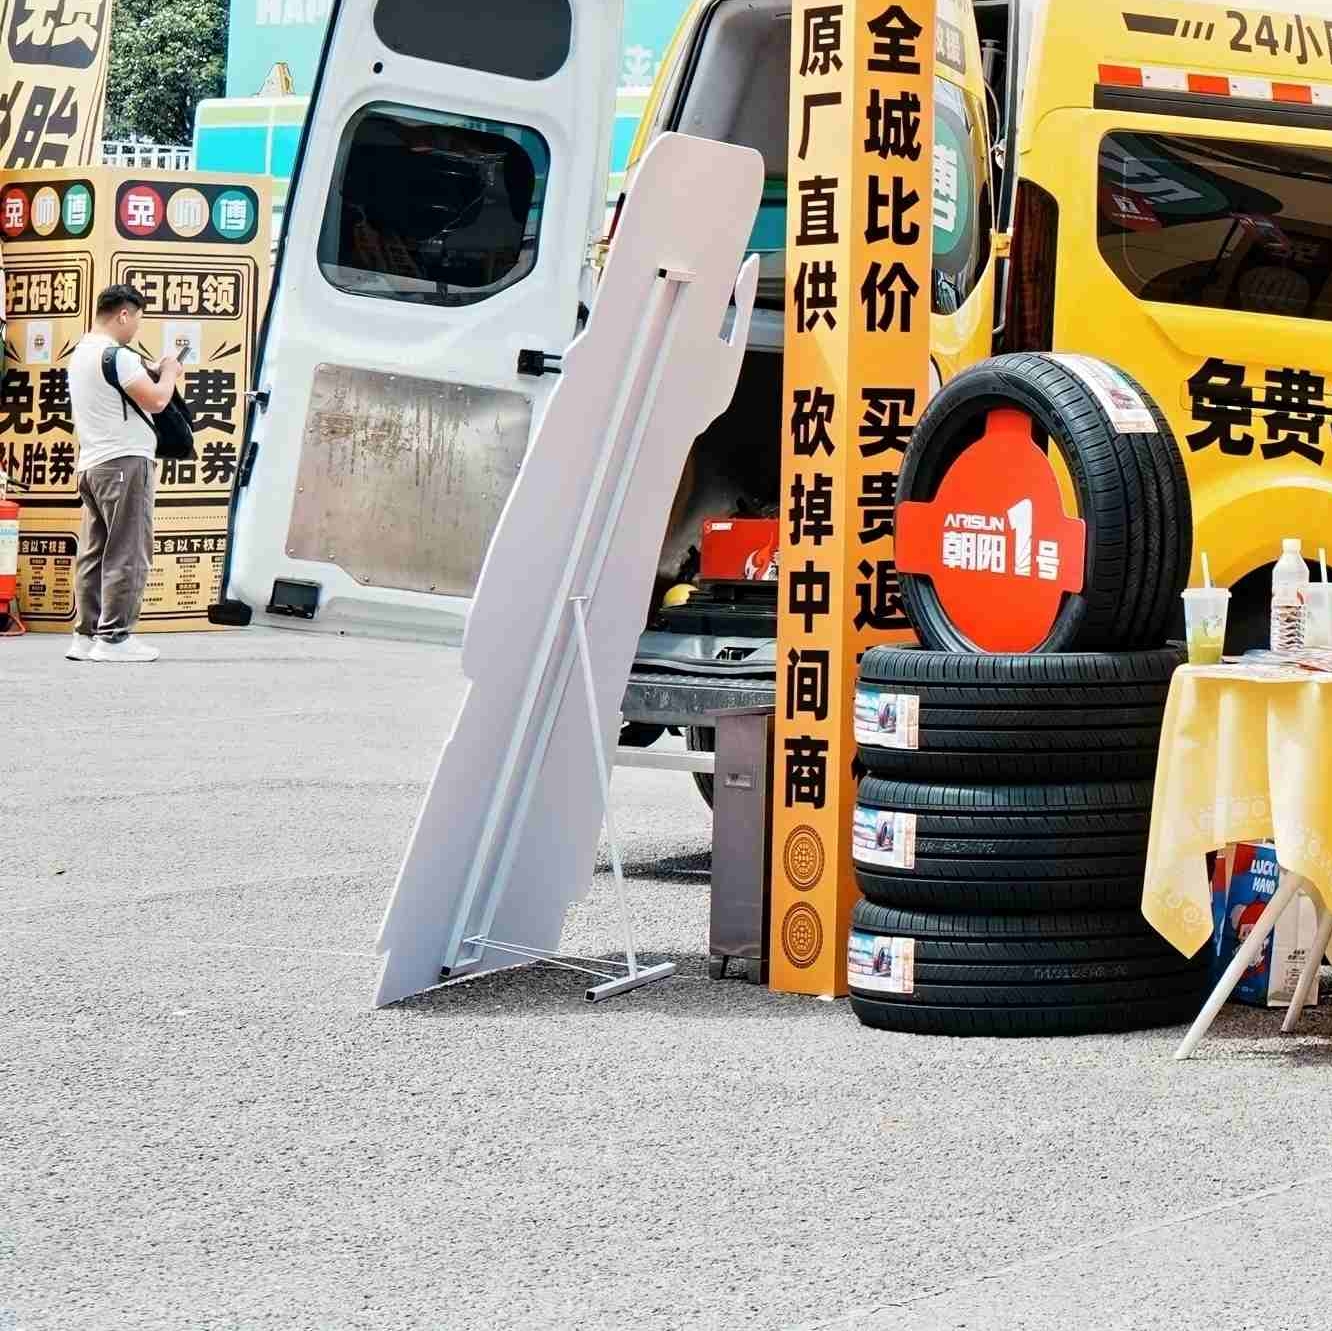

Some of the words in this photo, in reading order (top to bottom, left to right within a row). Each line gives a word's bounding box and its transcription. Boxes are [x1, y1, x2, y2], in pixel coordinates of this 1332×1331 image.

[794, 4, 844, 333] 原厂直供
[861, 4, 923, 333] 全城比价
[6, 272, 80, 312] 扫码领
[131, 275, 237, 314] 扫码领
[0, 369, 73, 434] 免费
[183, 370, 237, 435] 费
[161, 442, 237, 485] 胎券
[18, 540, 67, 554] 含以下权益
[942, 498, 1060, 581] 朝阳1号
[944, 514, 1005, 531] ARISUN
[783, 385, 836, 810] 砍掉中间商
